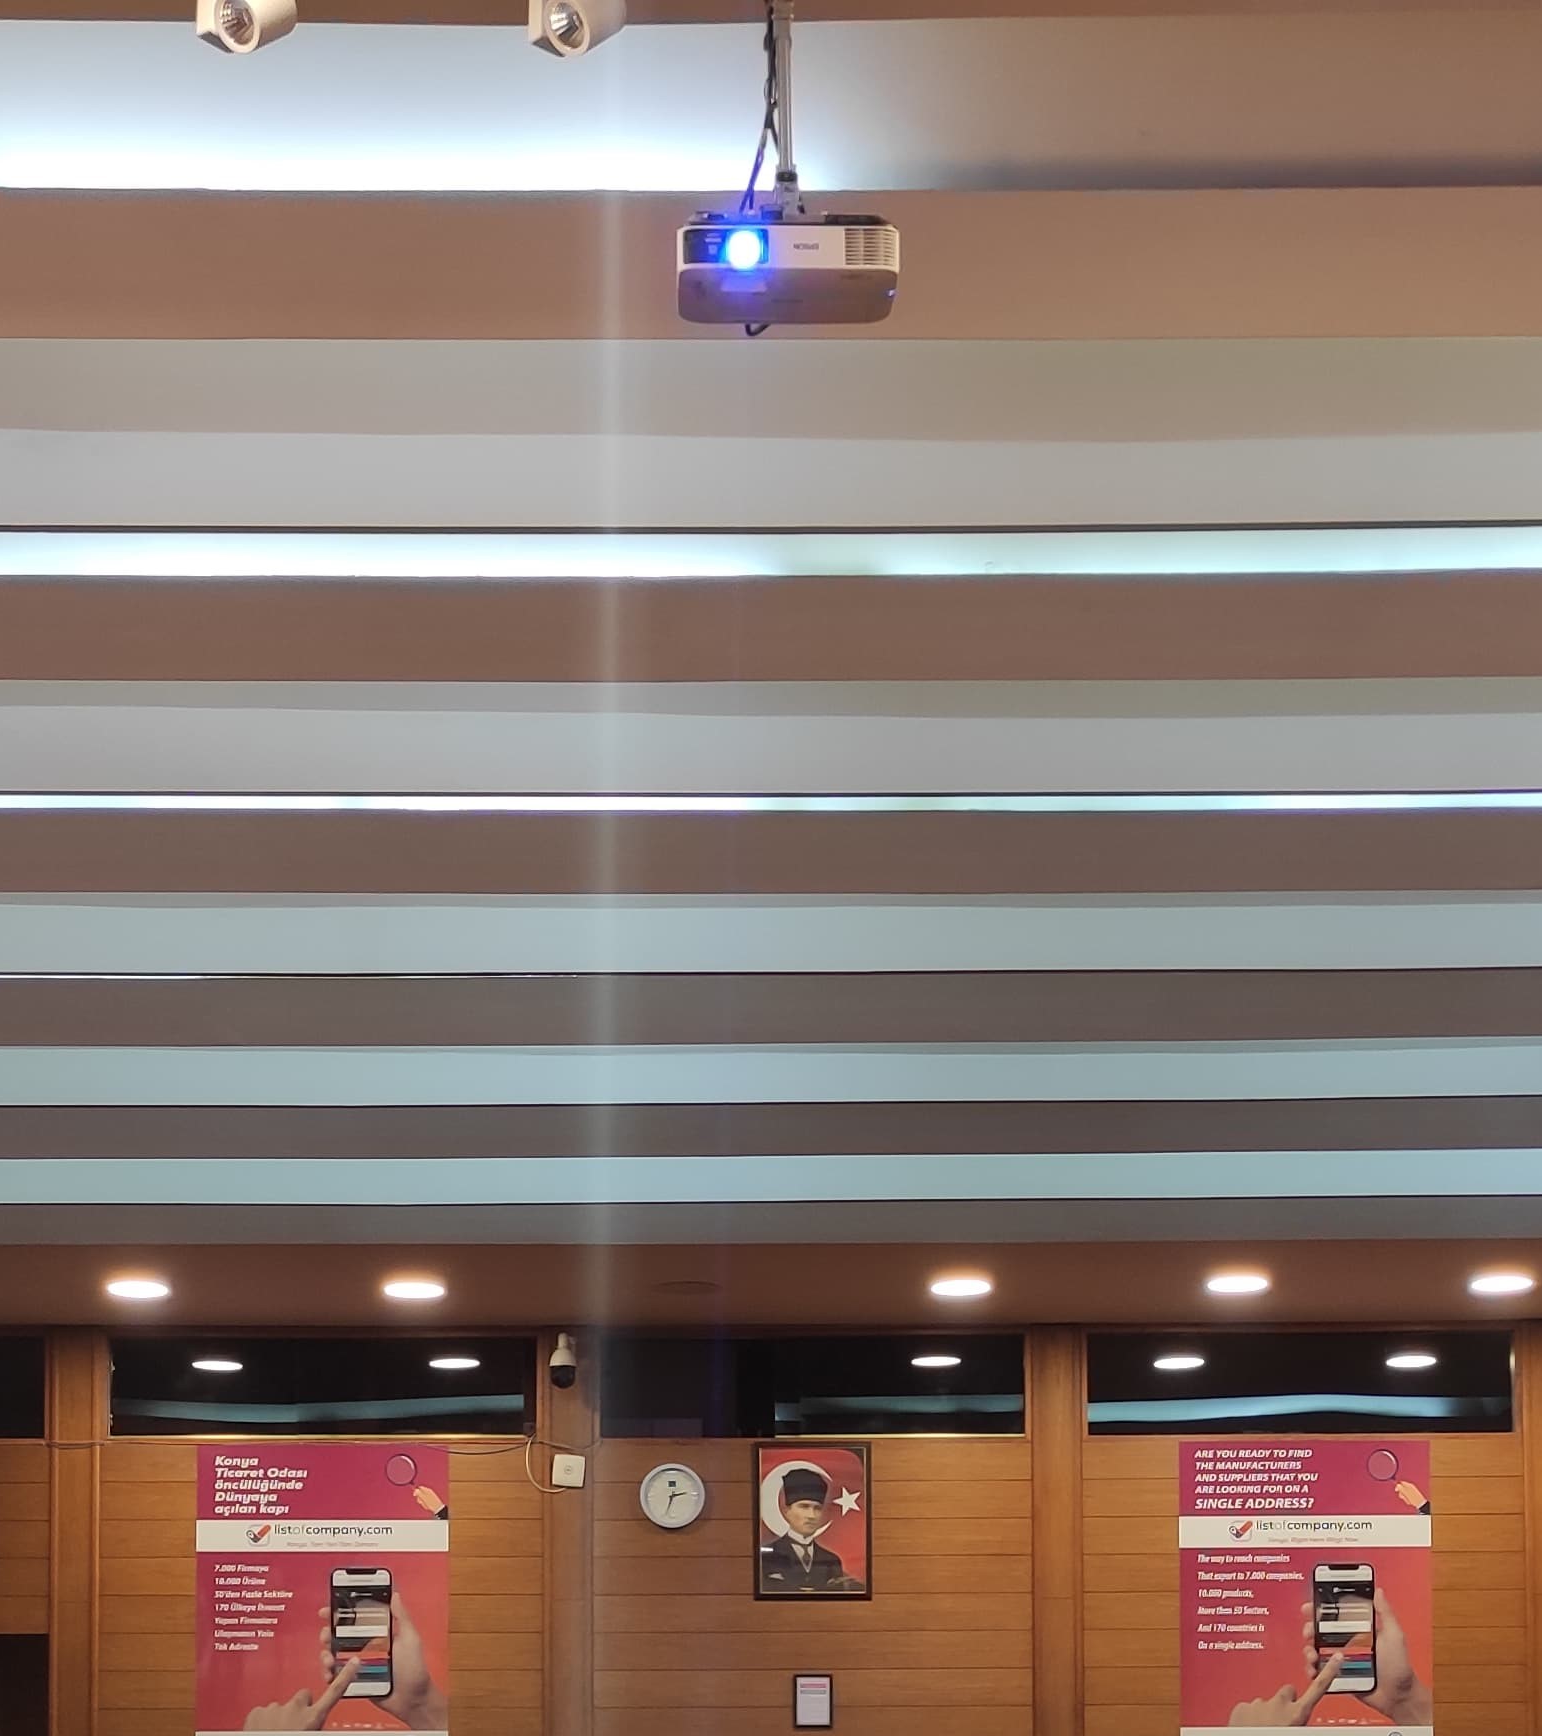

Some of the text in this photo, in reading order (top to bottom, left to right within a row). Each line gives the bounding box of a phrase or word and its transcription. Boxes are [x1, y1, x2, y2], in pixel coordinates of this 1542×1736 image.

[1195, 1449, 1313, 1458] ARE YOU READY TO FIND
[215, 1455, 259, 1468] Konya
[1195, 1461, 1302, 1470] THE MANUFACTURERS
[215, 1467, 308, 1478] Ticaret Odası
[1195, 1473, 1318, 1482] AND SUPPLIERS THAT YOU
[215, 1480, 304, 1492] öncülüğünde
[1195, 1484, 1309, 1494] ARE LOOKING FOR ON A
[215, 1492, 278, 1504] Dünyaya
[1195, 1498, 1314, 1509] SINGLE ADDRESS?
[215, 1503, 289, 1516] açılan kapı
[274, 1524, 393, 1537] listofcompany.com
[1256, 1520, 1373, 1532] listofcompany.com
[1225, 1554, 1233, 1563] to
